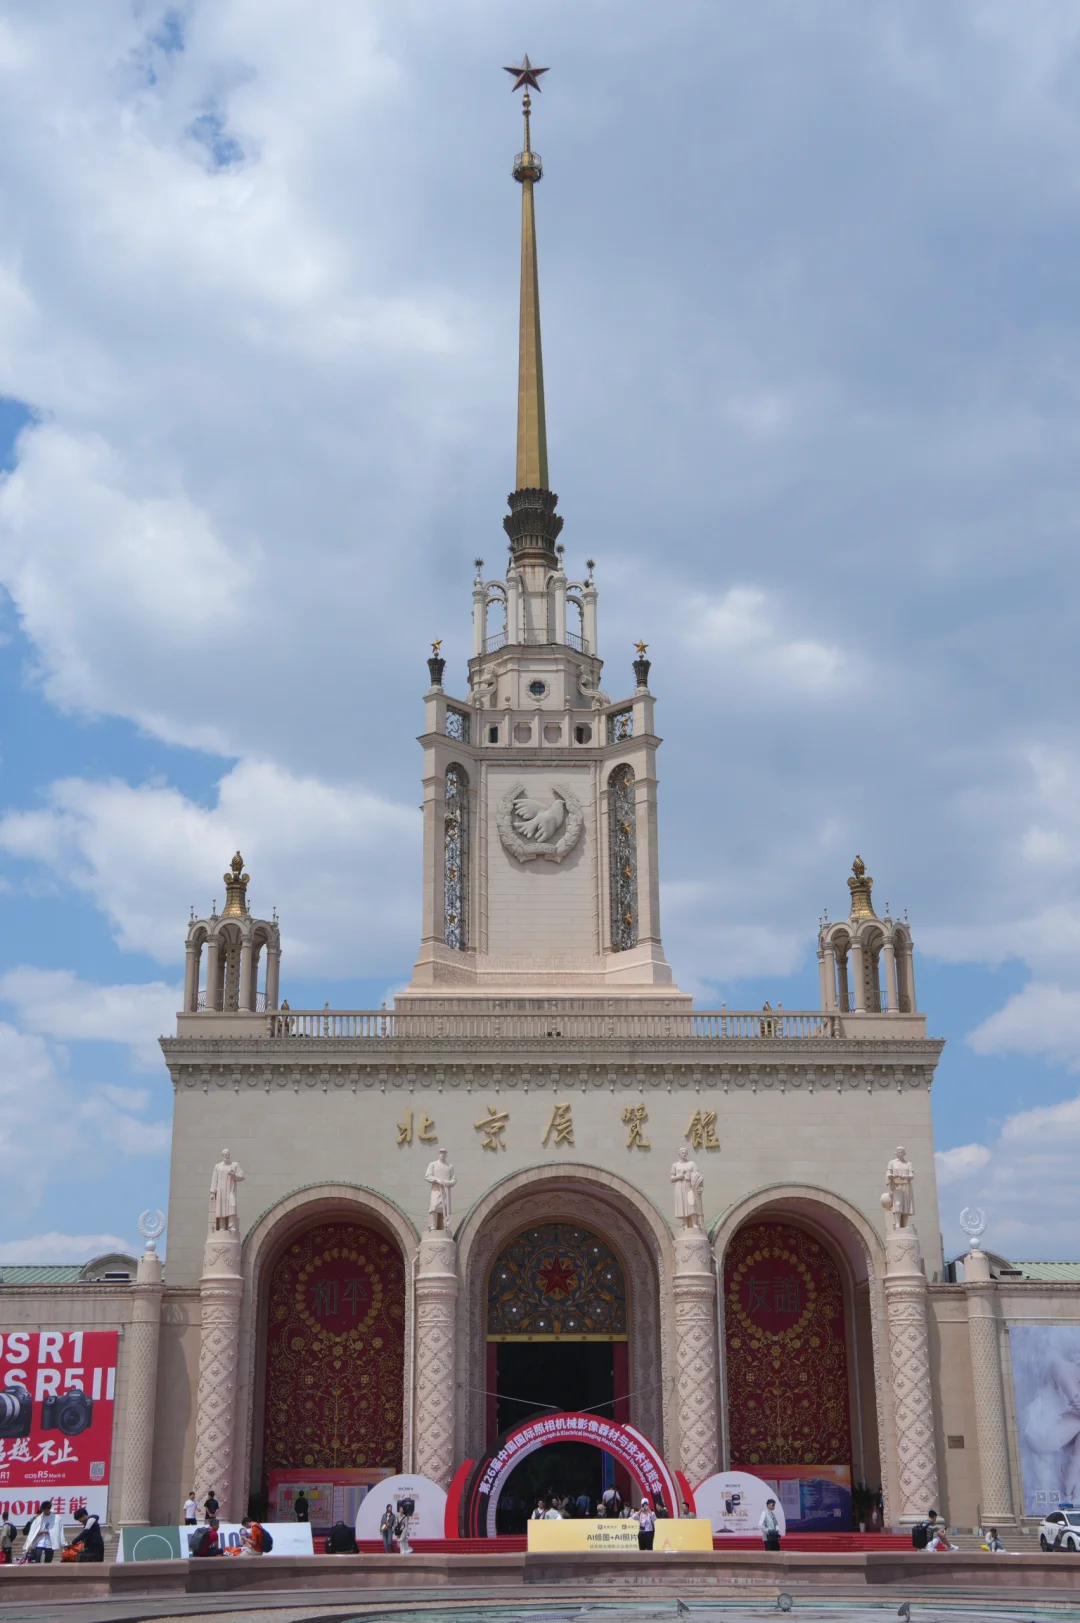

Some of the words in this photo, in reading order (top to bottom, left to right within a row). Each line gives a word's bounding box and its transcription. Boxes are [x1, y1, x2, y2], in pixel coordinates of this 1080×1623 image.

[396, 1102, 720, 1151] 北京展覽館
[310, 1277, 369, 1317] 和平
[0, 1331, 30, 1365] S
[37, 1331, 84, 1364] R1
[35, 1368, 84, 1402] R5
[37, 1470, 48, 1479] R5
[478, 1417, 663, 1495] 第26届中国国际照相机械影像器材与技术博览会
[529, 1431, 555, 1444] Photograph
[582, 1431, 601, 1442] Imaging
[601, 1437, 623, 1454] Machinery
[628, 1458, 647, 1483] Technology
